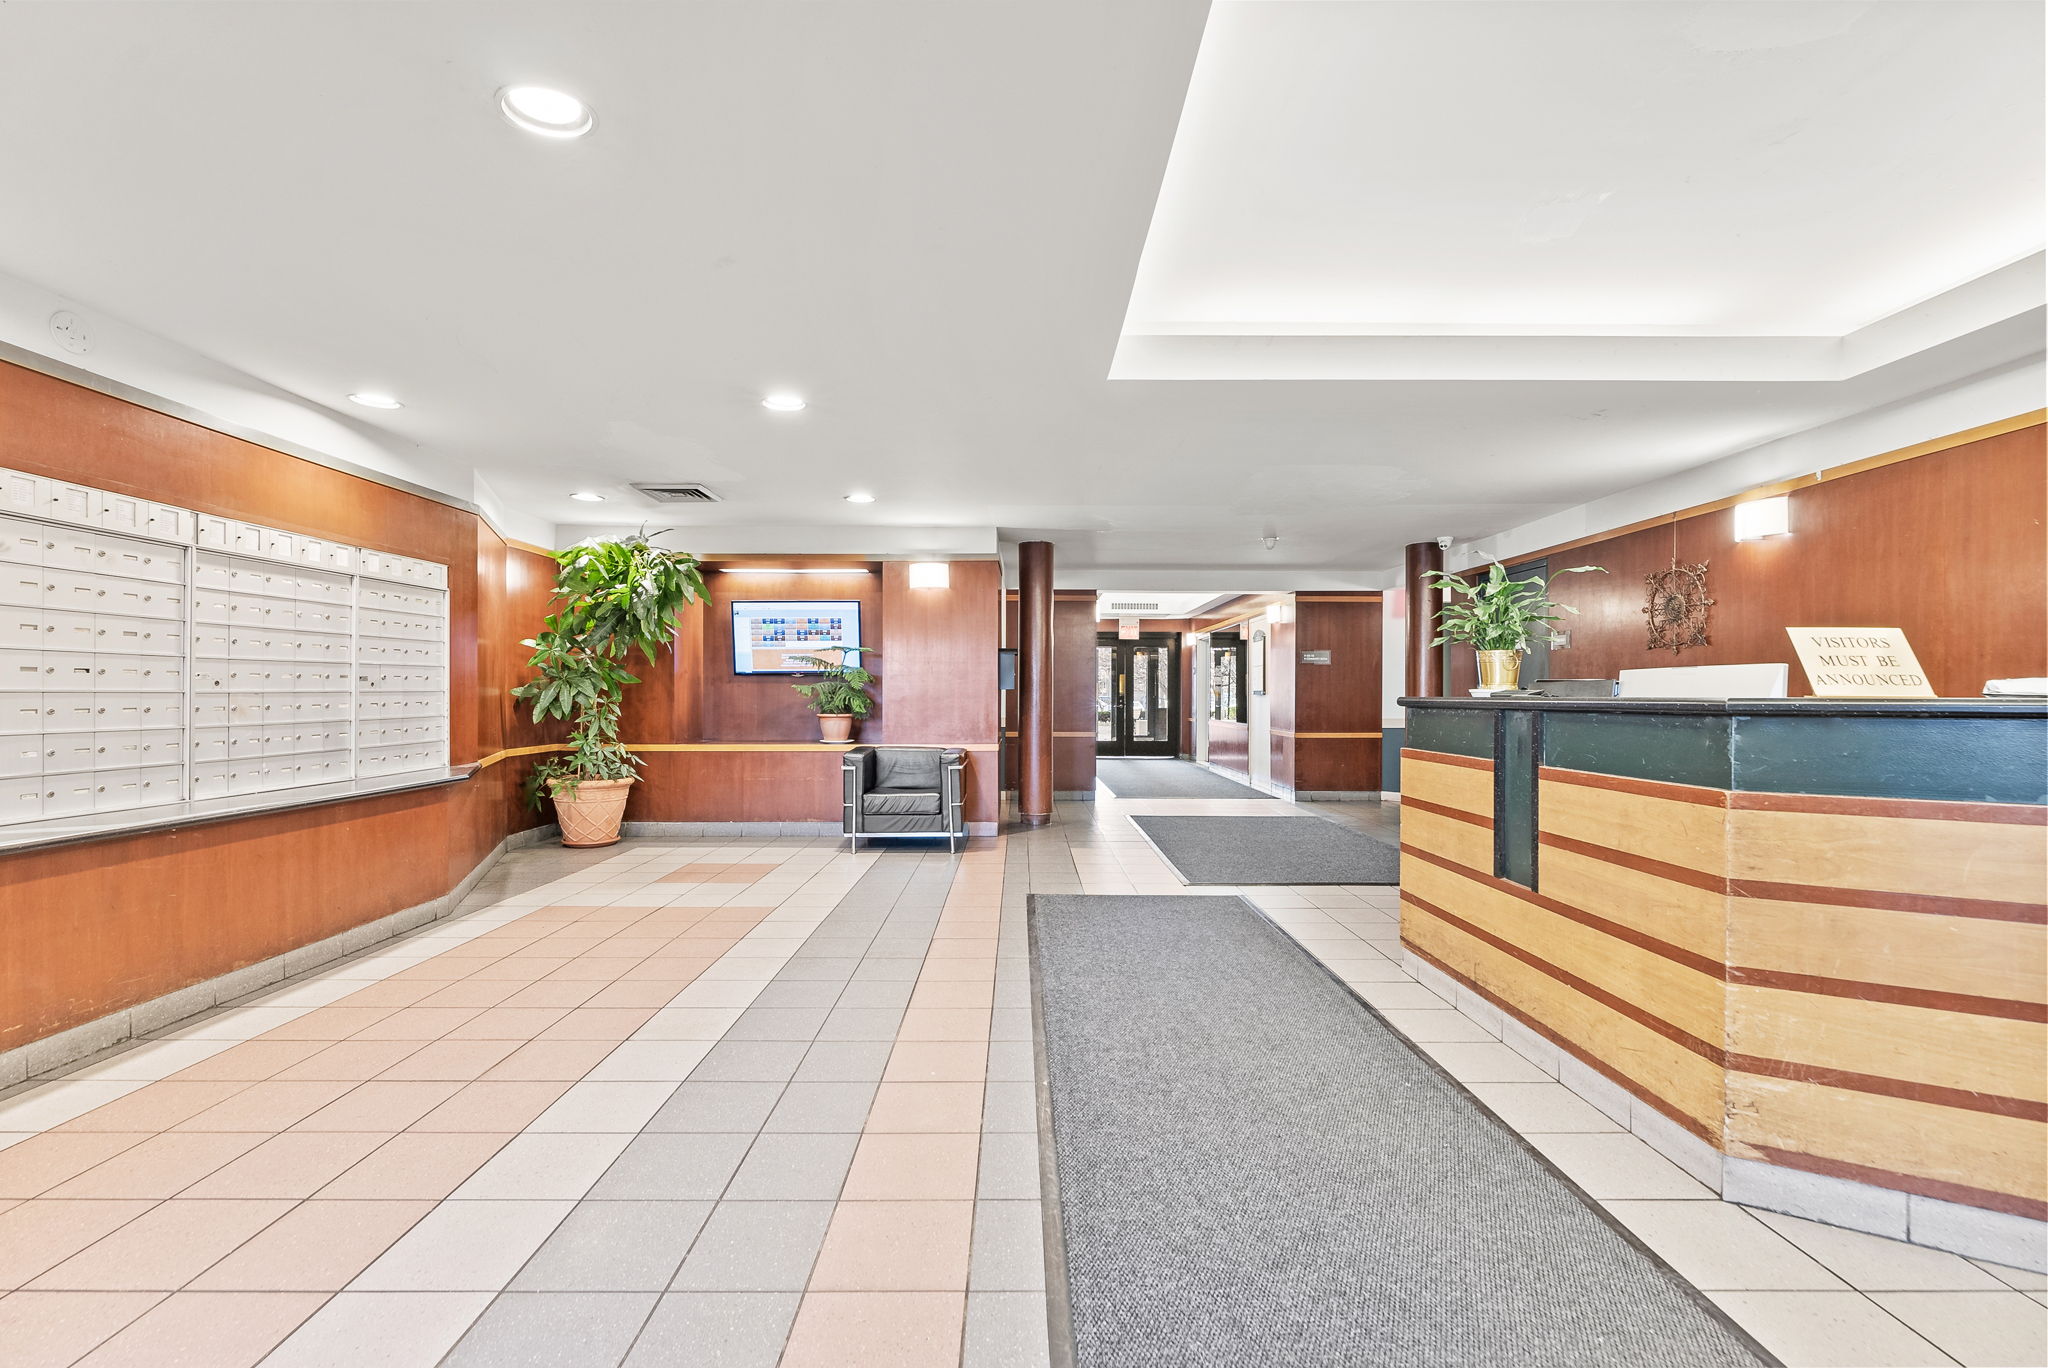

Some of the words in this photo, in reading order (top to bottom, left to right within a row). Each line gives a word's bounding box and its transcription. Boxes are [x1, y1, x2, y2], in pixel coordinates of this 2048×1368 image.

[1811, 636, 1891, 648] VISITORS
[1819, 655, 1868, 667] MUST
[1877, 656, 1901, 667] BE
[1816, 674, 1922, 686] ANNOUNCED
